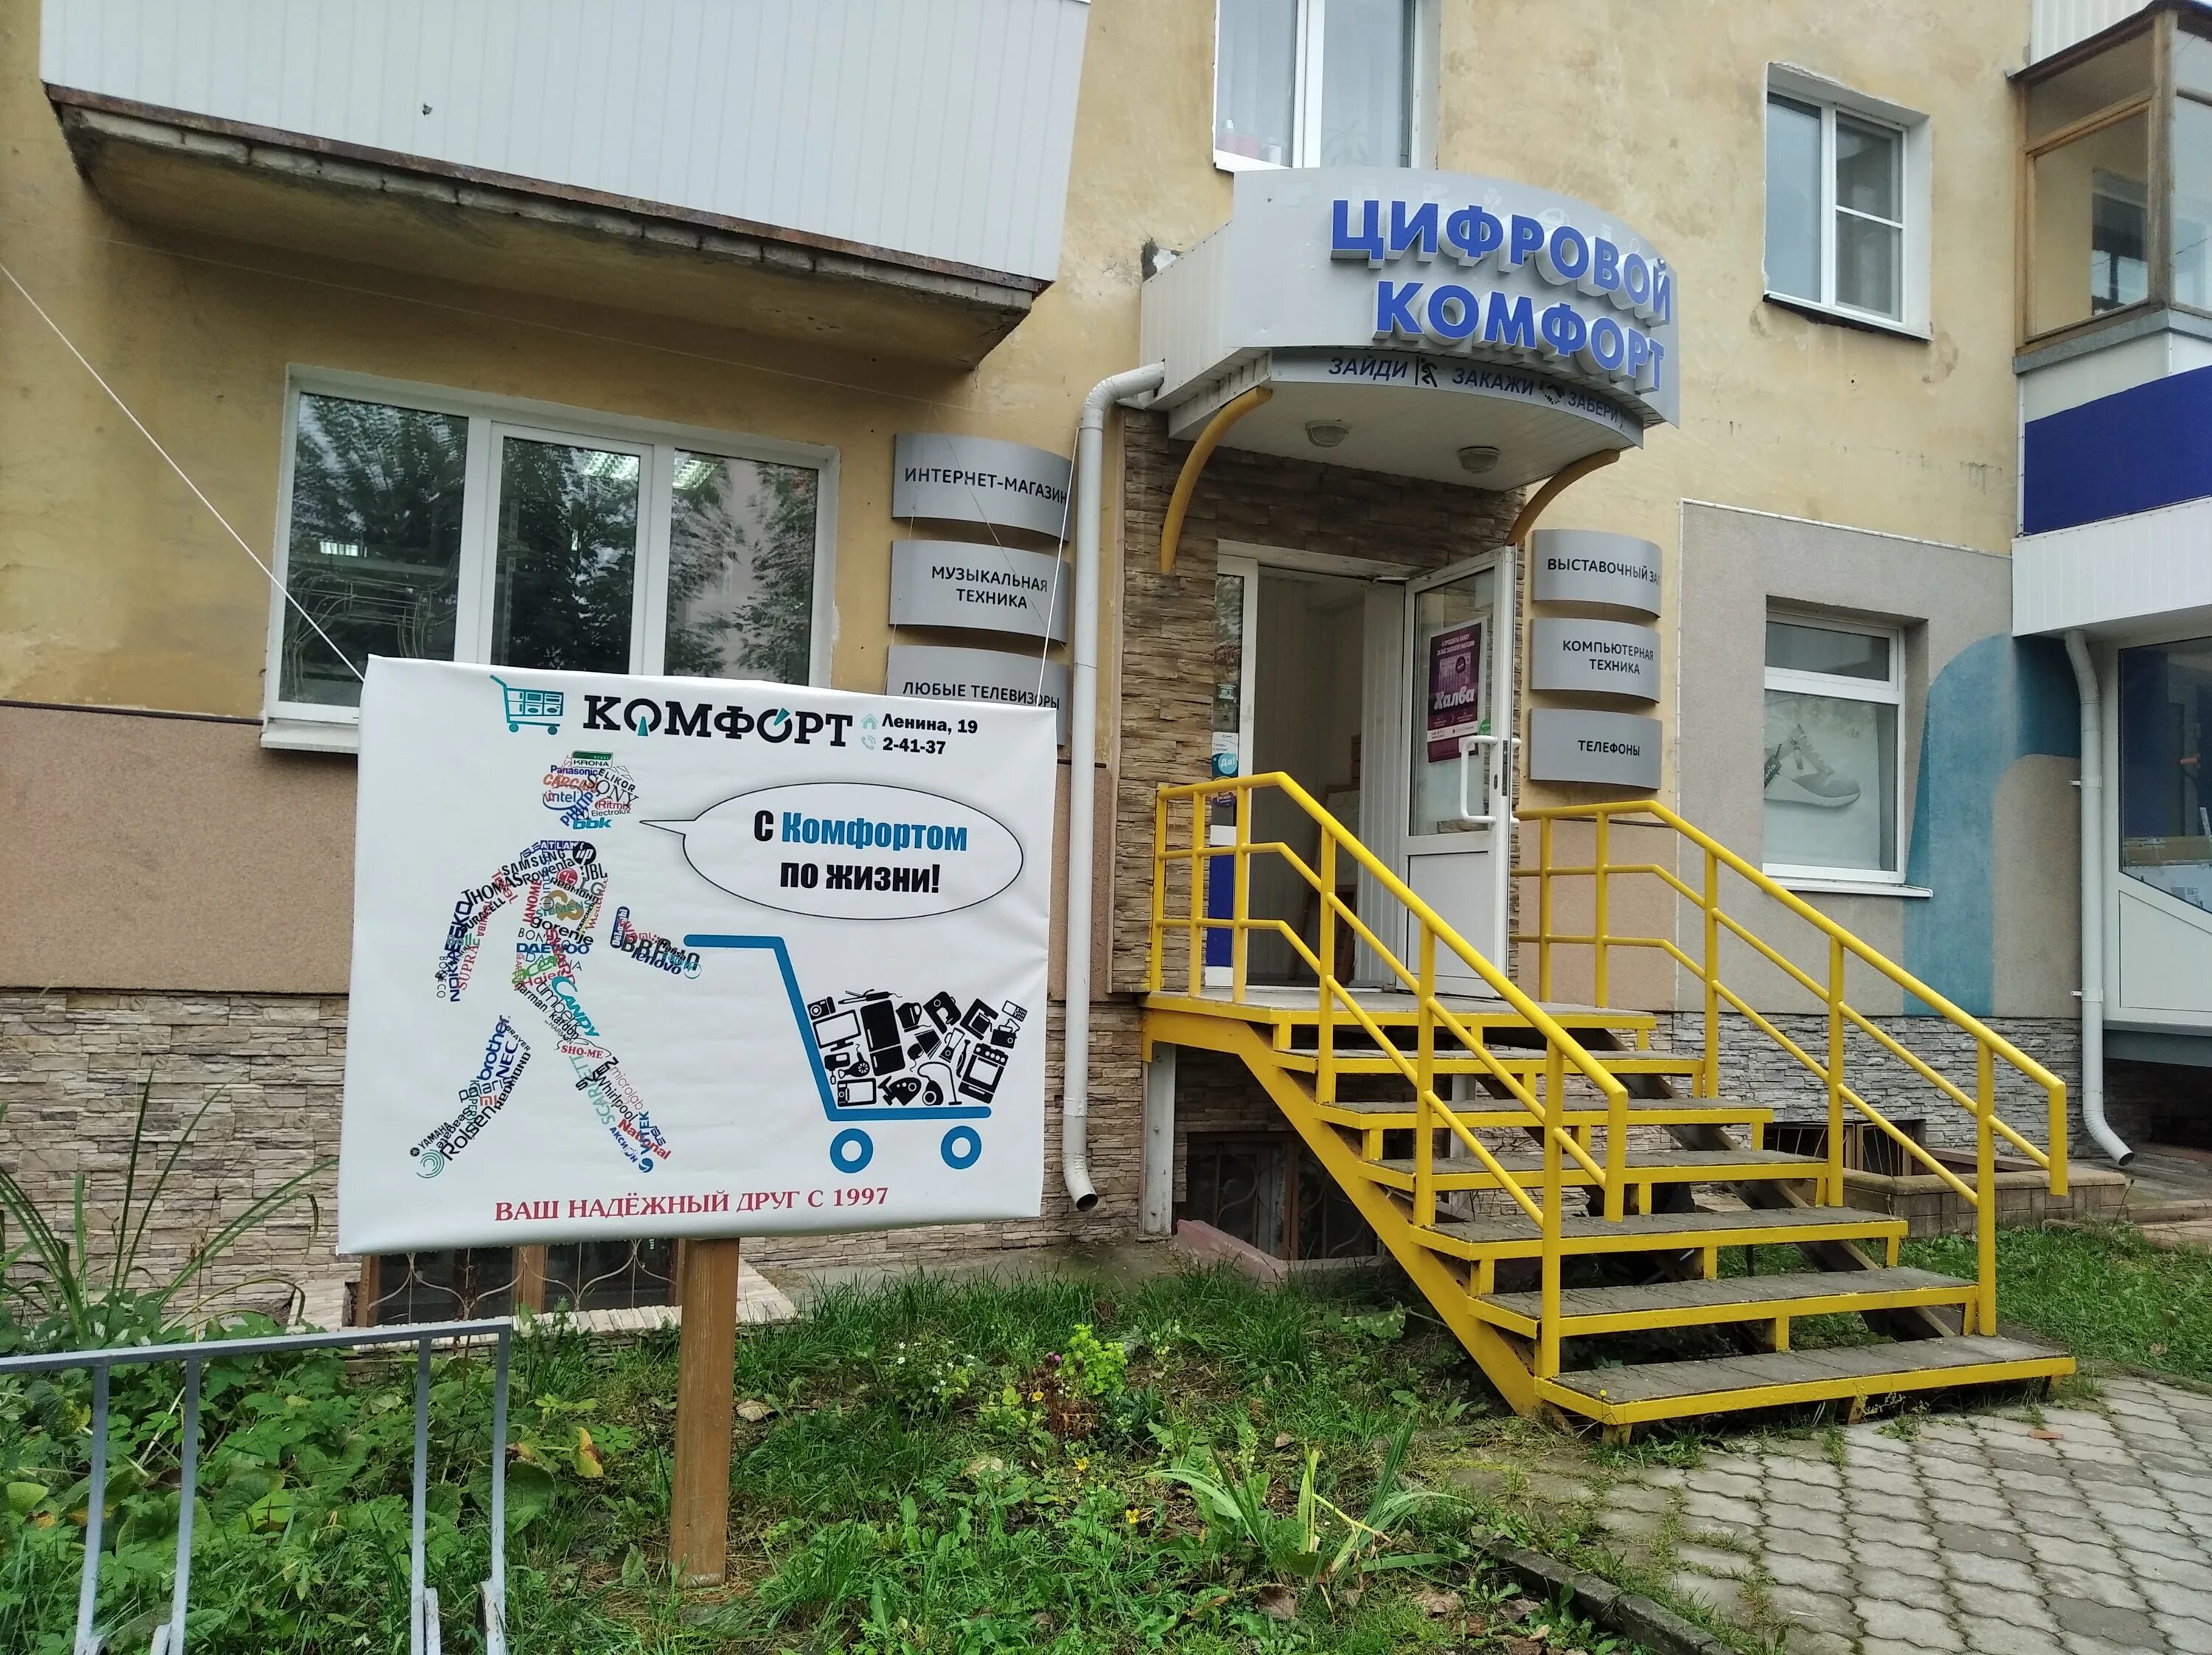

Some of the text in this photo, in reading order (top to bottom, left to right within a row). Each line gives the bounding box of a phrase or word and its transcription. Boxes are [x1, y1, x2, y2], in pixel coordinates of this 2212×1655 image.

[1331, 199, 1671, 325] ЦИФРОВОЙ
[1376, 280, 1664, 392] КОМФОРТ
[1328, 355, 1619, 423] ЗАЙДИ ЗАКАЖИ ЗАБЕРИ
[904, 467, 1068, 504] ИНТЕРНЕТ-МАГАЗИН
[931, 565, 1048, 593] МУЗЫКАЛЬНАЯ
[1547, 558, 1649, 581] ВЫСТАВОЧНЫЙ
[956, 588, 1028, 609] ТЕХНИКА
[1562, 639, 1654, 662] КОМПЬЮТЕРНАЯ
[1589, 658, 1641, 675] ТЕХНИКА
[902, 681, 1060, 710] ЛЮБЫЕ ТЕЛЕВИЗОРЫ
[1433, 685, 1475, 711] Халва
[582, 693, 978, 748] КОМФОРТ Ленина, 19
[882, 738, 947, 754] 2-41-37
[1578, 740, 1641, 757] ТЕЛЕФОНЫ
[550, 765, 599, 776] Panasonic
[573, 759, 610, 767] KRONA
[583, 774, 639, 807] SONY
[598, 768, 636, 793] ELIKOR
[591, 808, 631, 817] Electrolux
[782, 811, 967, 851] Комфортом
[501, 850, 566, 876] SAMSUNG
[780, 862, 940, 893] по жизни!
[529, 916, 594, 946] gorenje
[551, 976, 601, 1037] CANDY
[476, 1015, 509, 1081] brother
[505, 1024, 532, 1052] BRAYER
[560, 1044, 604, 1060] SHO-ME
[495, 1040, 519, 1078] NEC
[417, 1121, 451, 1150] YAMAHA
[494, 1187, 889, 1221] ВАШ НАДЁЖНЫЙ ДРУГ С 1997
